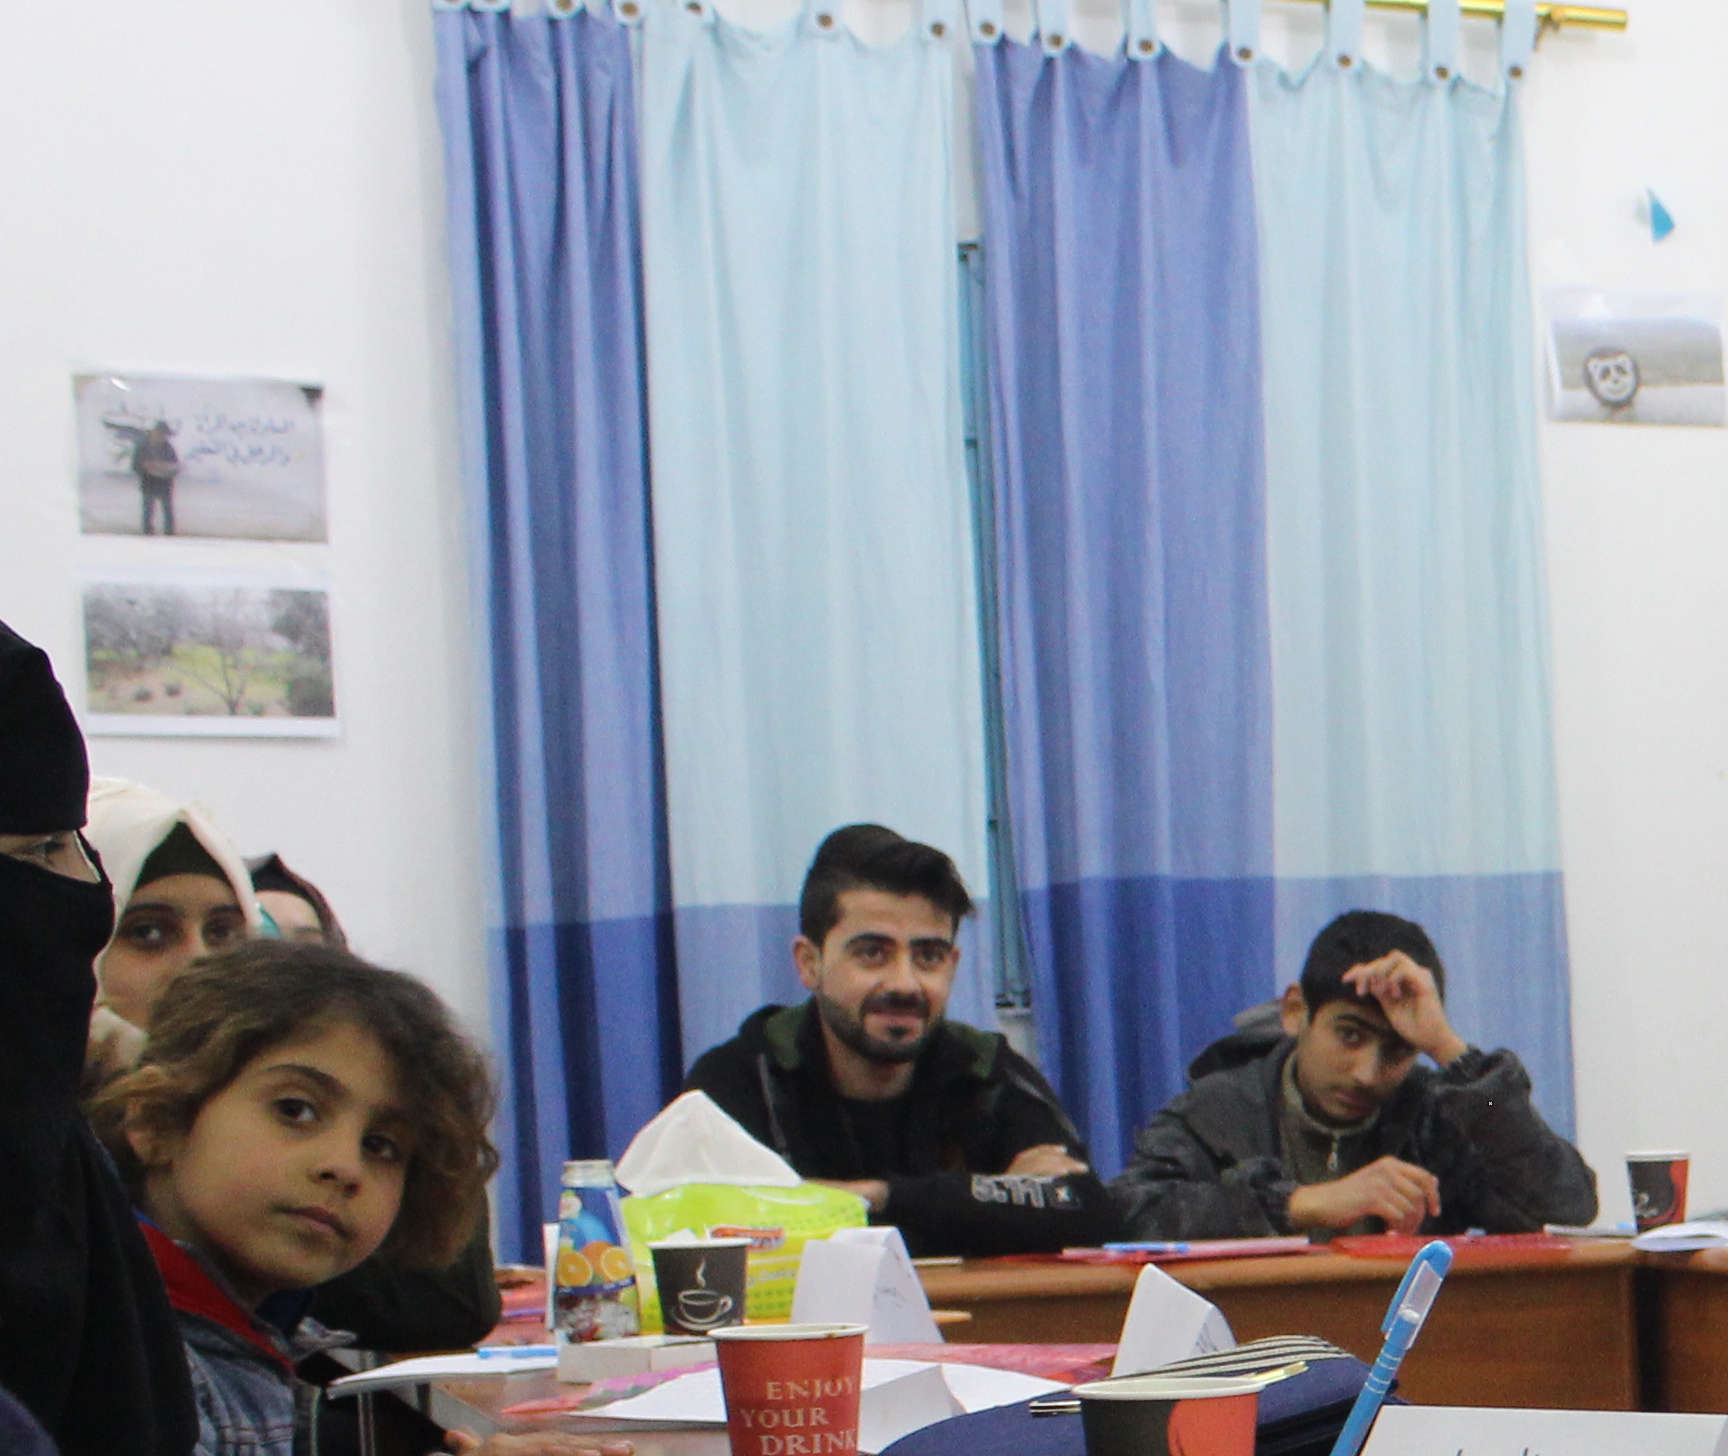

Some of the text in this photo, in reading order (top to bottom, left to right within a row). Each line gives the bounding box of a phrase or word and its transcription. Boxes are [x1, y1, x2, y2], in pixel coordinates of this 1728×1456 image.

[766, 1377, 856, 1401] ENJOY
[740, 1407, 830, 1429] YOUR
[760, 1429, 857, 1456] DRINK
